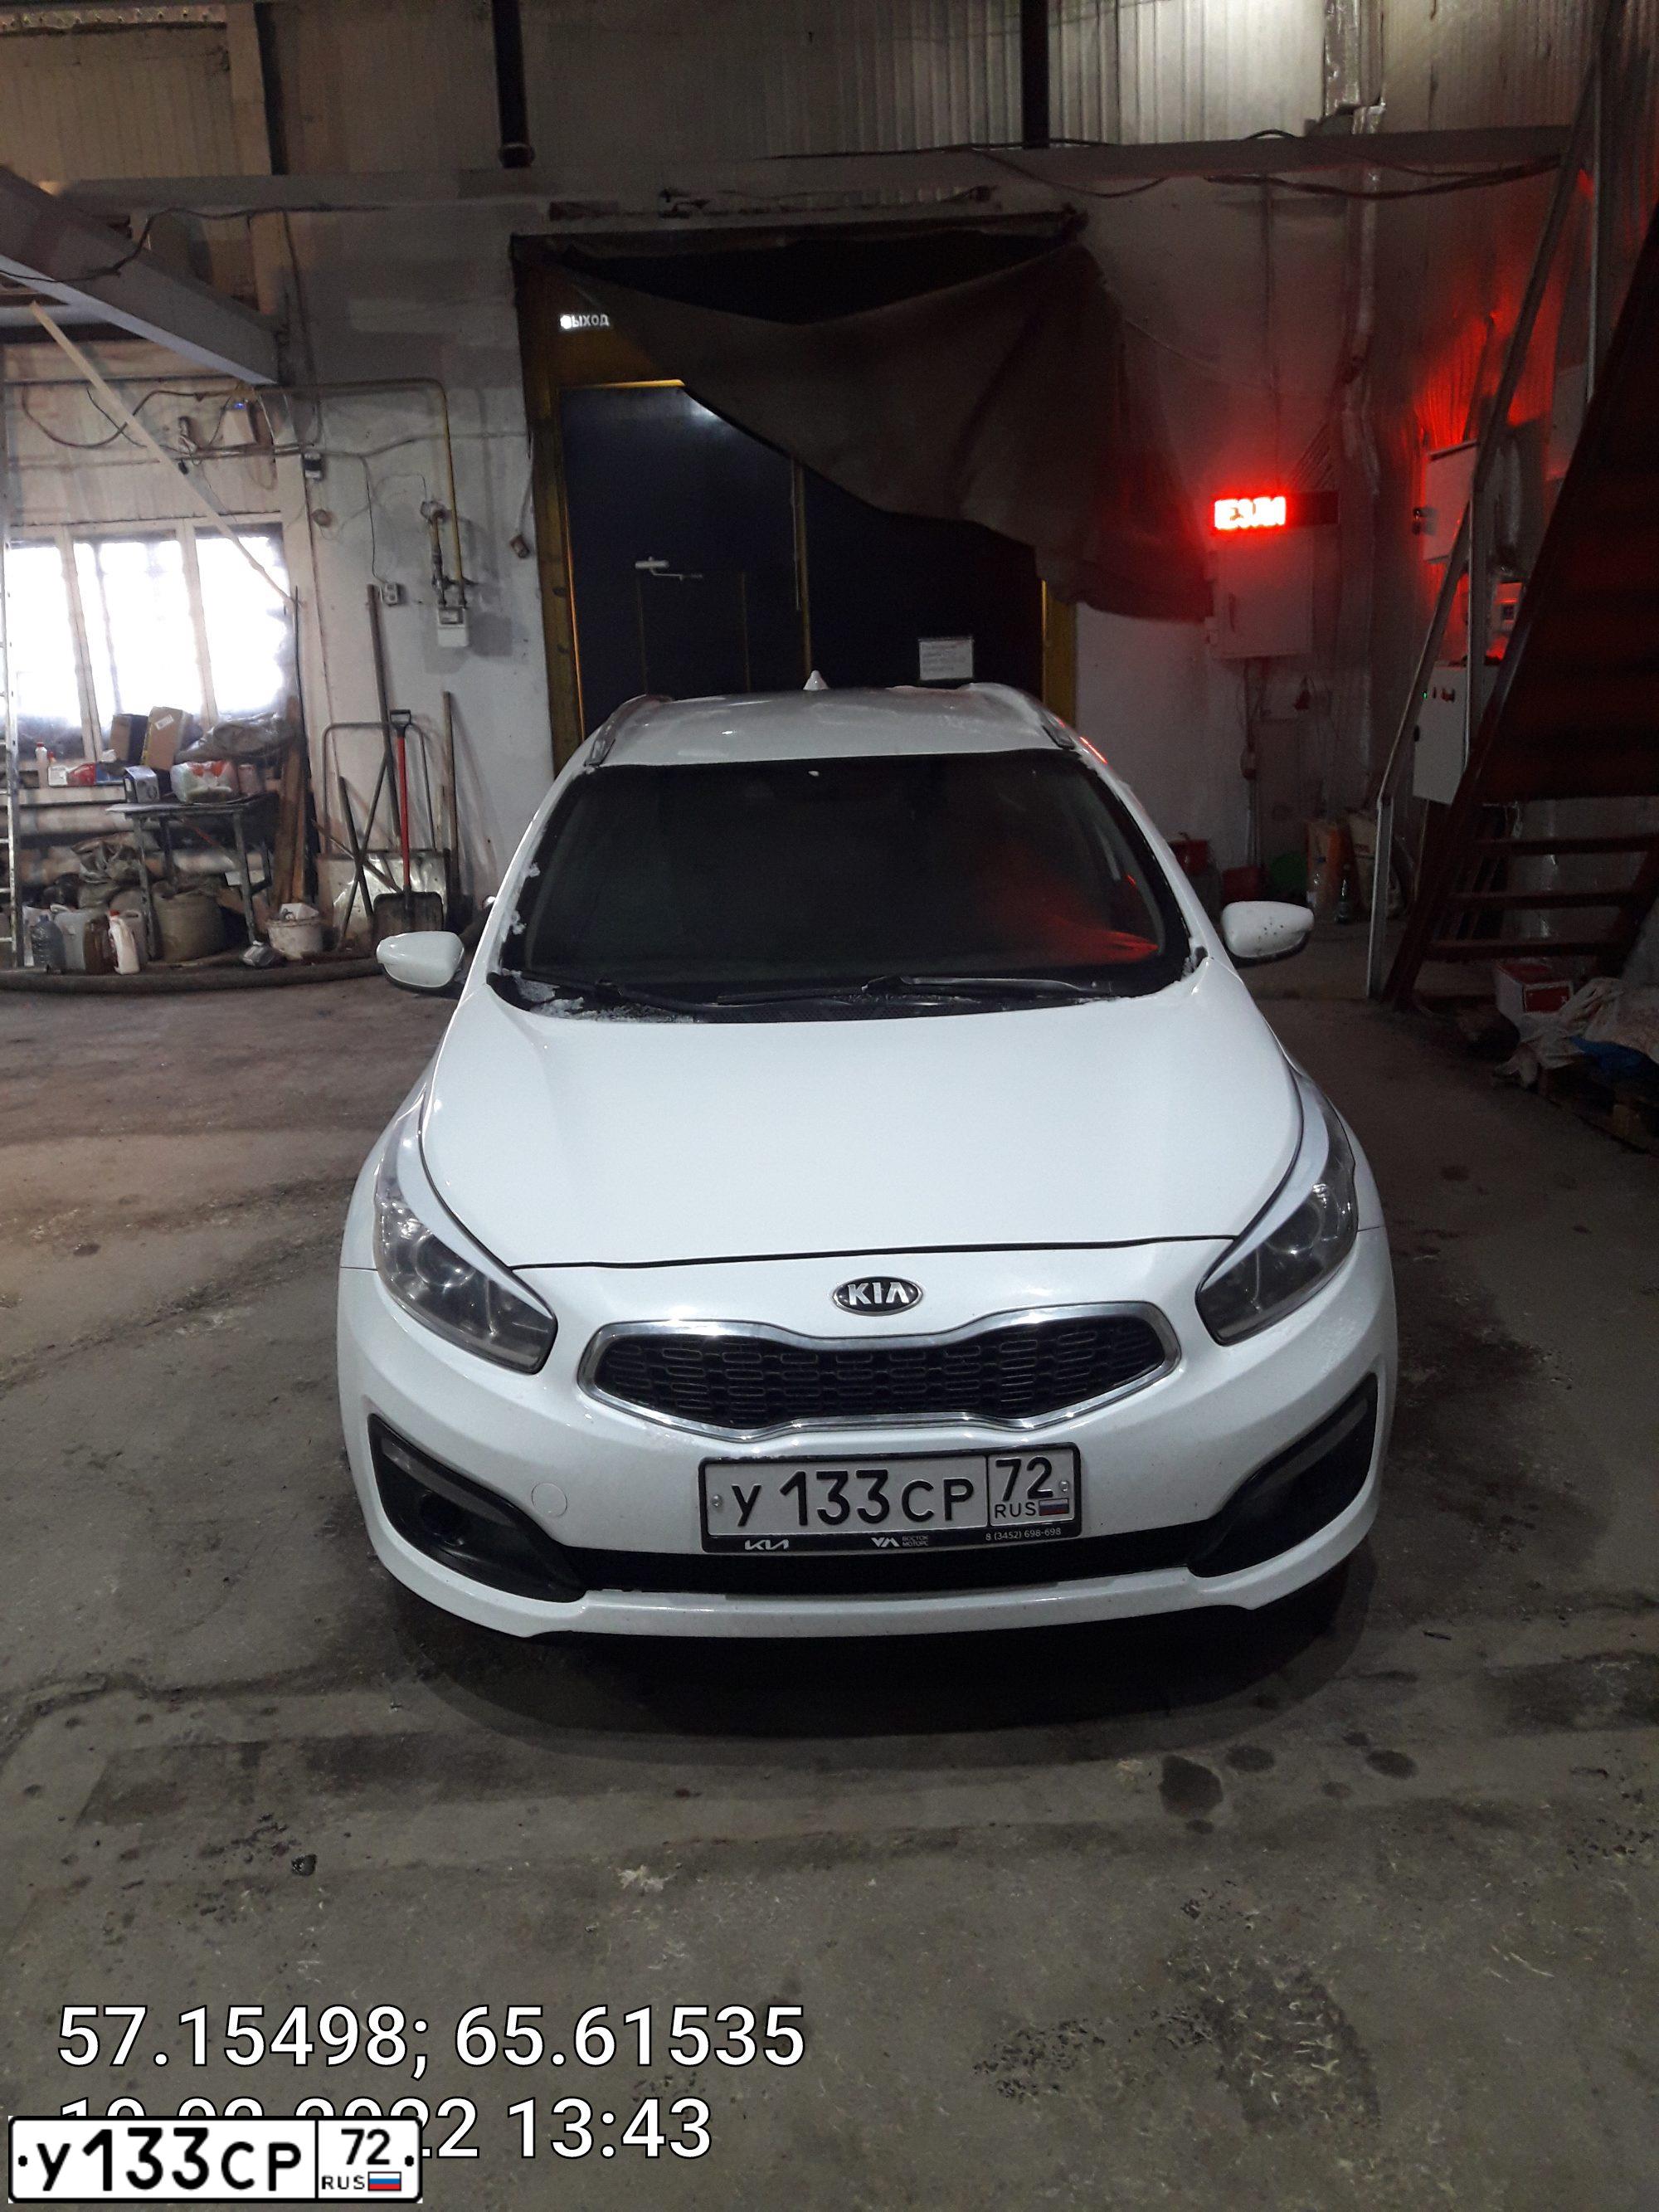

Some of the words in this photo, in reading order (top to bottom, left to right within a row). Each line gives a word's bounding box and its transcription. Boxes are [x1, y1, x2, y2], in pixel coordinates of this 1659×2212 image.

[560, 314, 610, 329] ЫХОД
[847, 1282, 909, 1306] KIA
[995, 1455, 1053, 1503] 72
[995, 1502, 1037, 1519] RUS
[995, 1529, 1021, 1541] (3452)
[1024, 1527, 1062, 1538] 698-698
